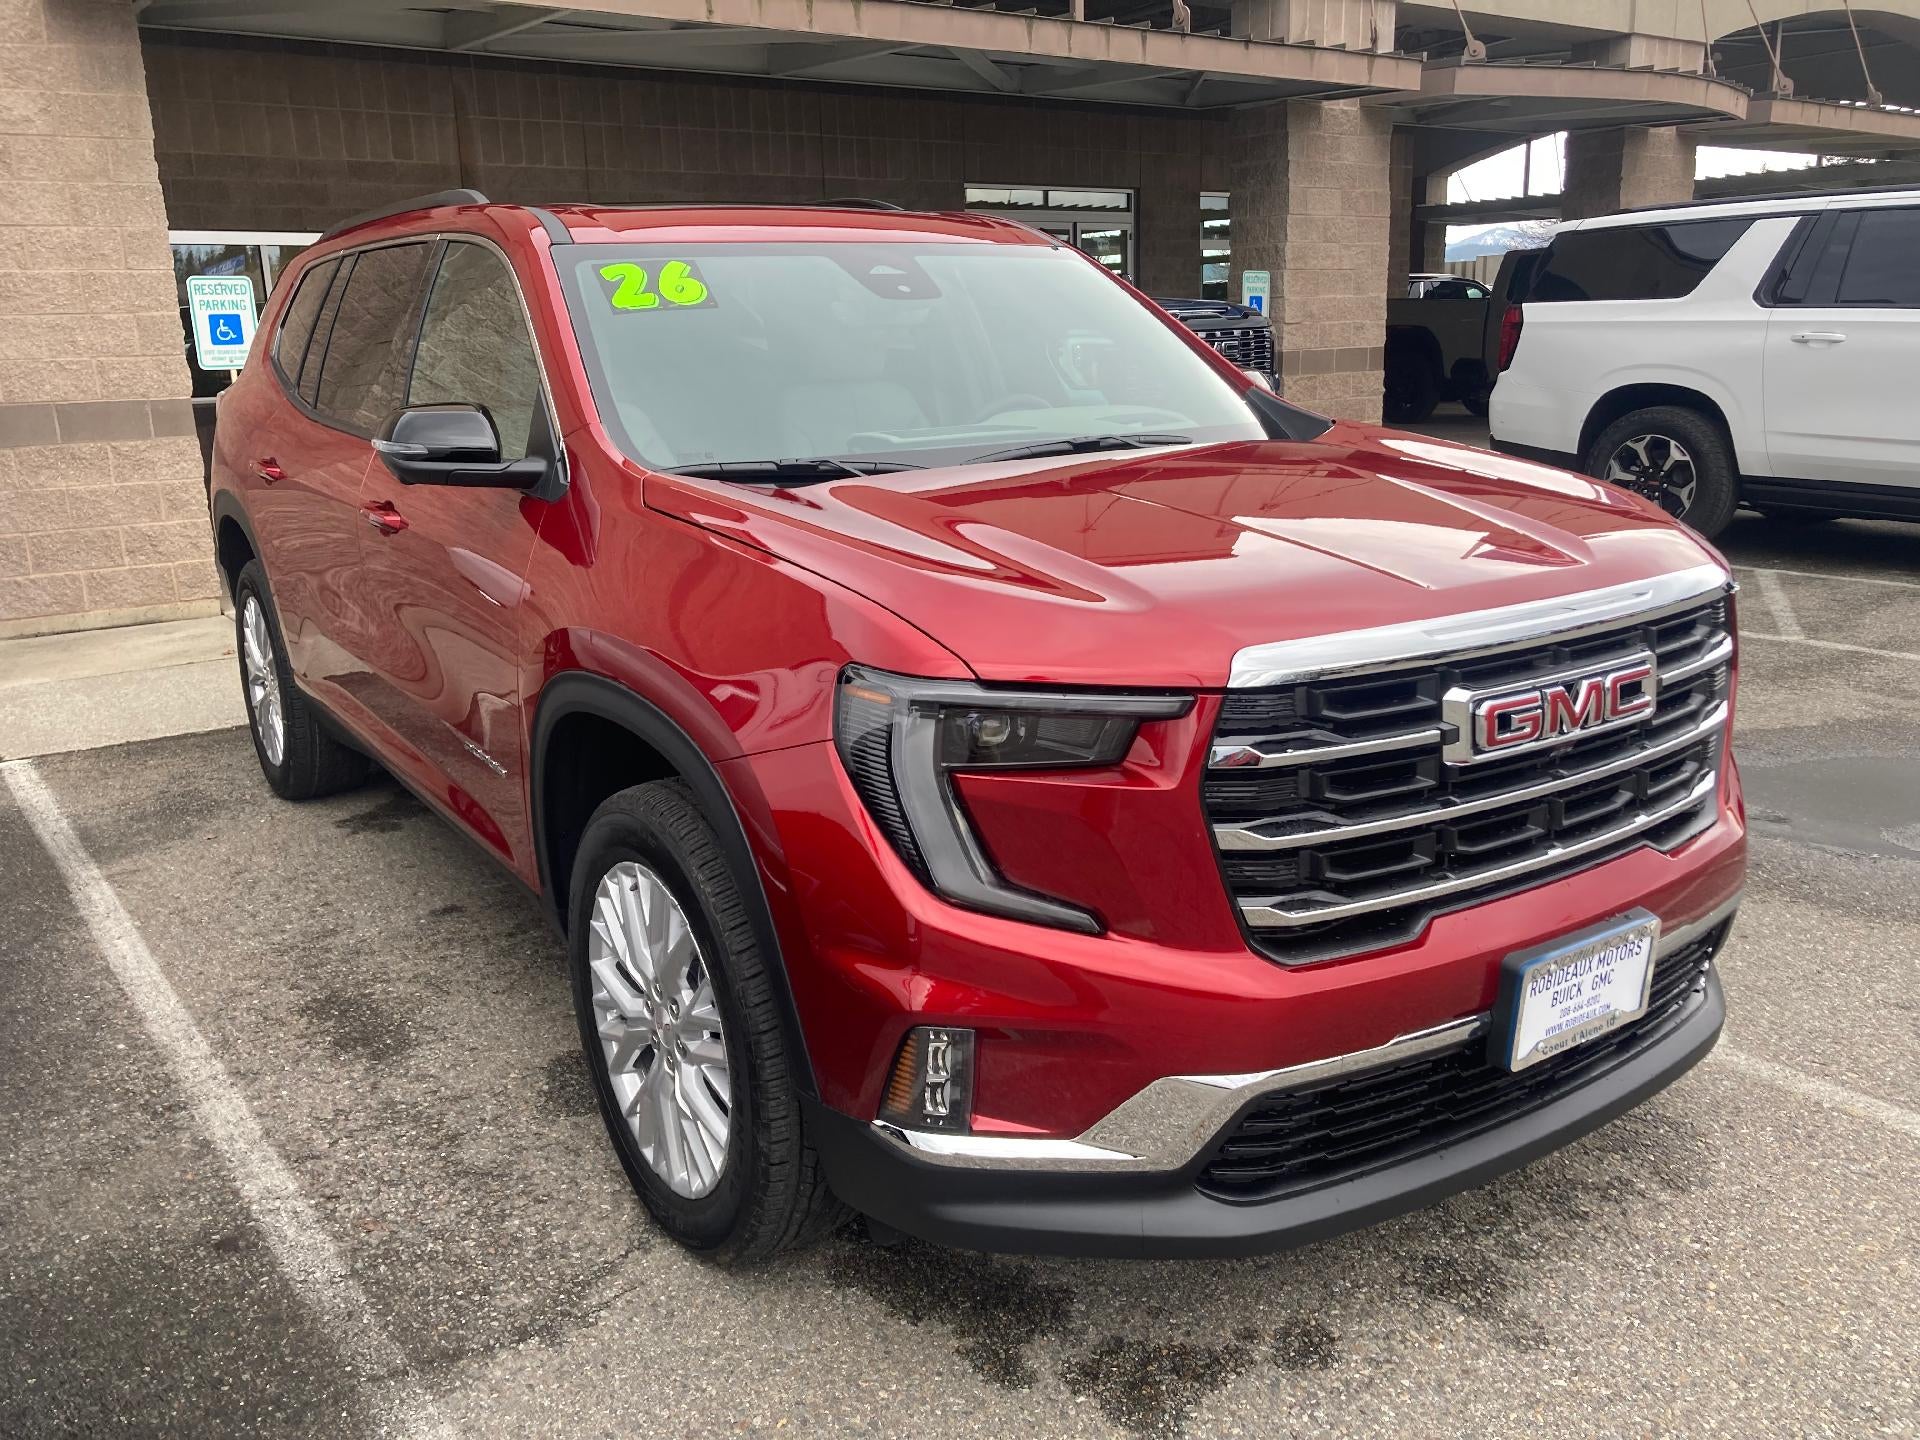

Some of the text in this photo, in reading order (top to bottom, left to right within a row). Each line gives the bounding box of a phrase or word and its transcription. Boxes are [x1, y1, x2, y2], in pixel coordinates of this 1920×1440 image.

[193, 284, 247, 296] RESERVED
[199, 299, 247, 311] PARKING
[599, 260, 708, 310] 26
[1475, 664, 1655, 751] GMC
[1530, 955, 1594, 998] ROBIDEAUX
[1596, 939, 1643, 970] MOTORS
[1551, 968, 1615, 1008] BUICK GMC
[1542, 1039, 1568, 1055] Coeur
